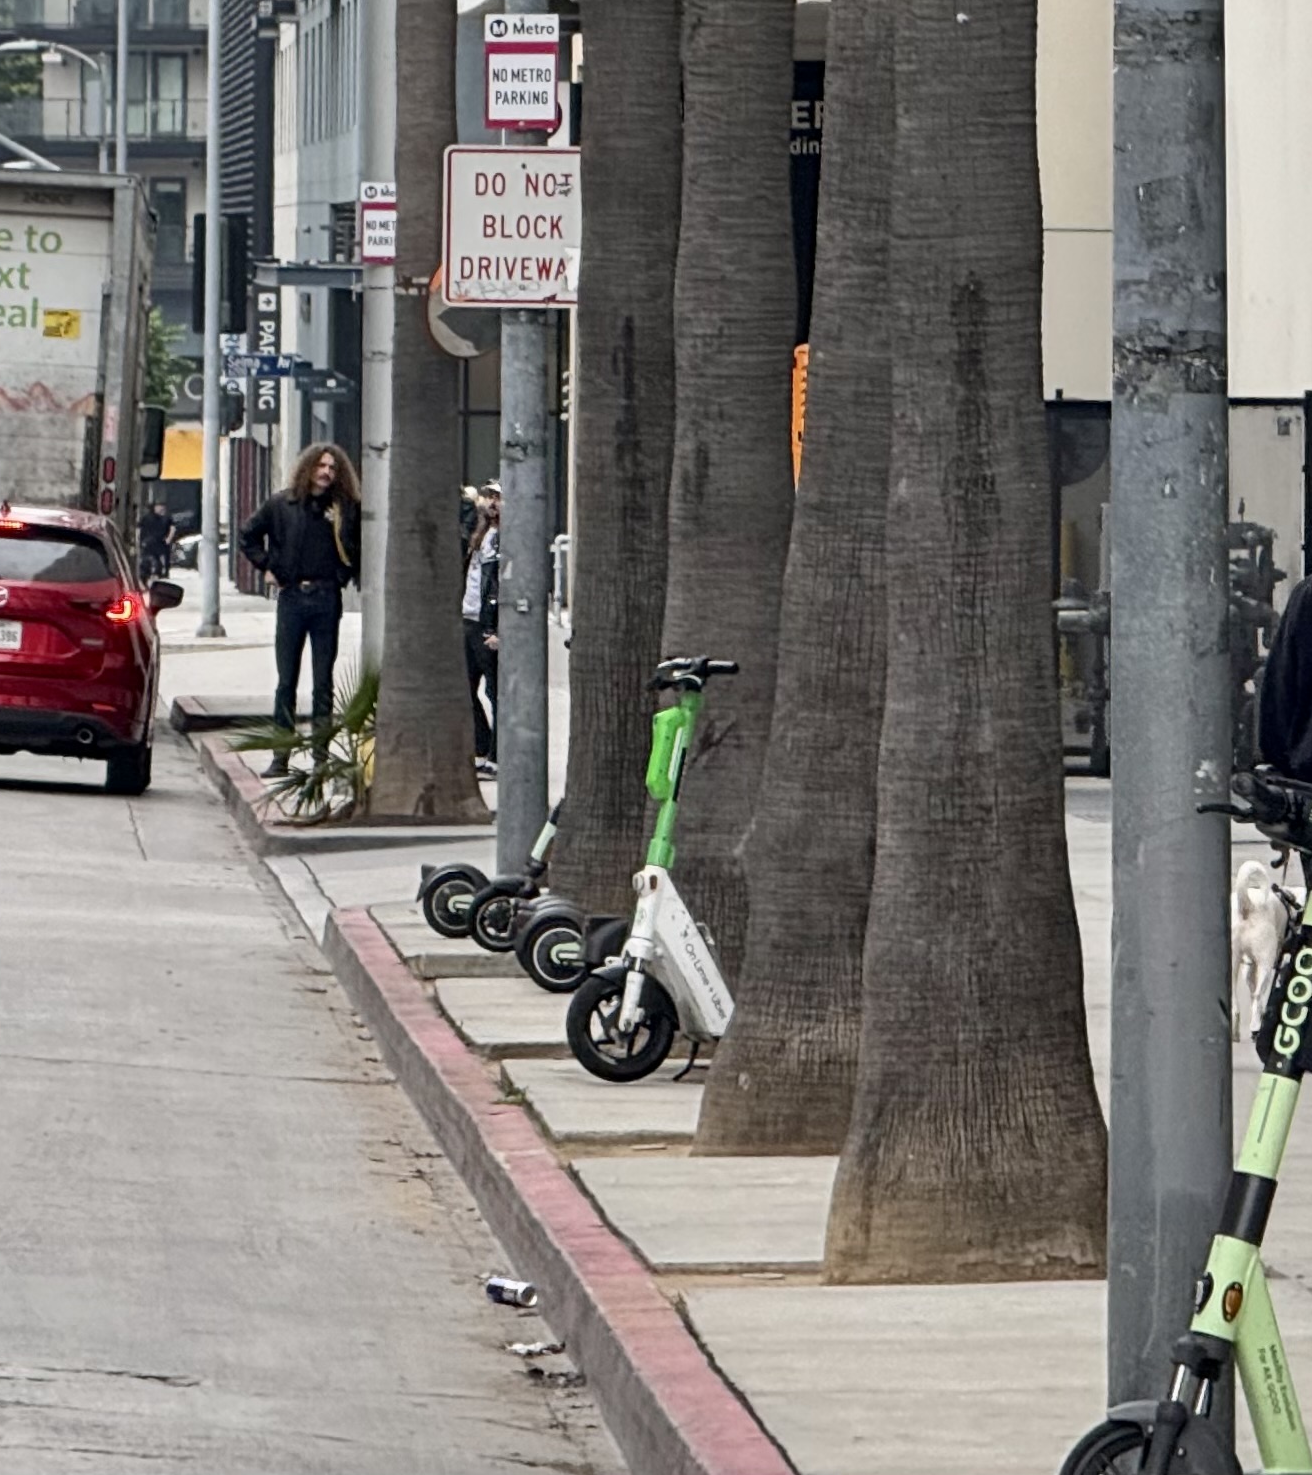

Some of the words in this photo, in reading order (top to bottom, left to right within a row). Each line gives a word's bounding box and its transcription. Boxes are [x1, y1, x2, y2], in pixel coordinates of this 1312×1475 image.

[512, 23, 555, 35] Metro
[492, 68, 508, 82] NO
[511, 68, 551, 82] METRO
[495, 91, 549, 105] PARKING
[475, 172, 506, 196] DO
[366, 220, 377, 230] NO
[379, 220, 396, 231] MET
[483, 214, 563, 239] BLOCK
[24, 224, 63, 254] to
[368, 236, 393, 245] PARKI
[460, 256, 567, 280] DRIVEWA
